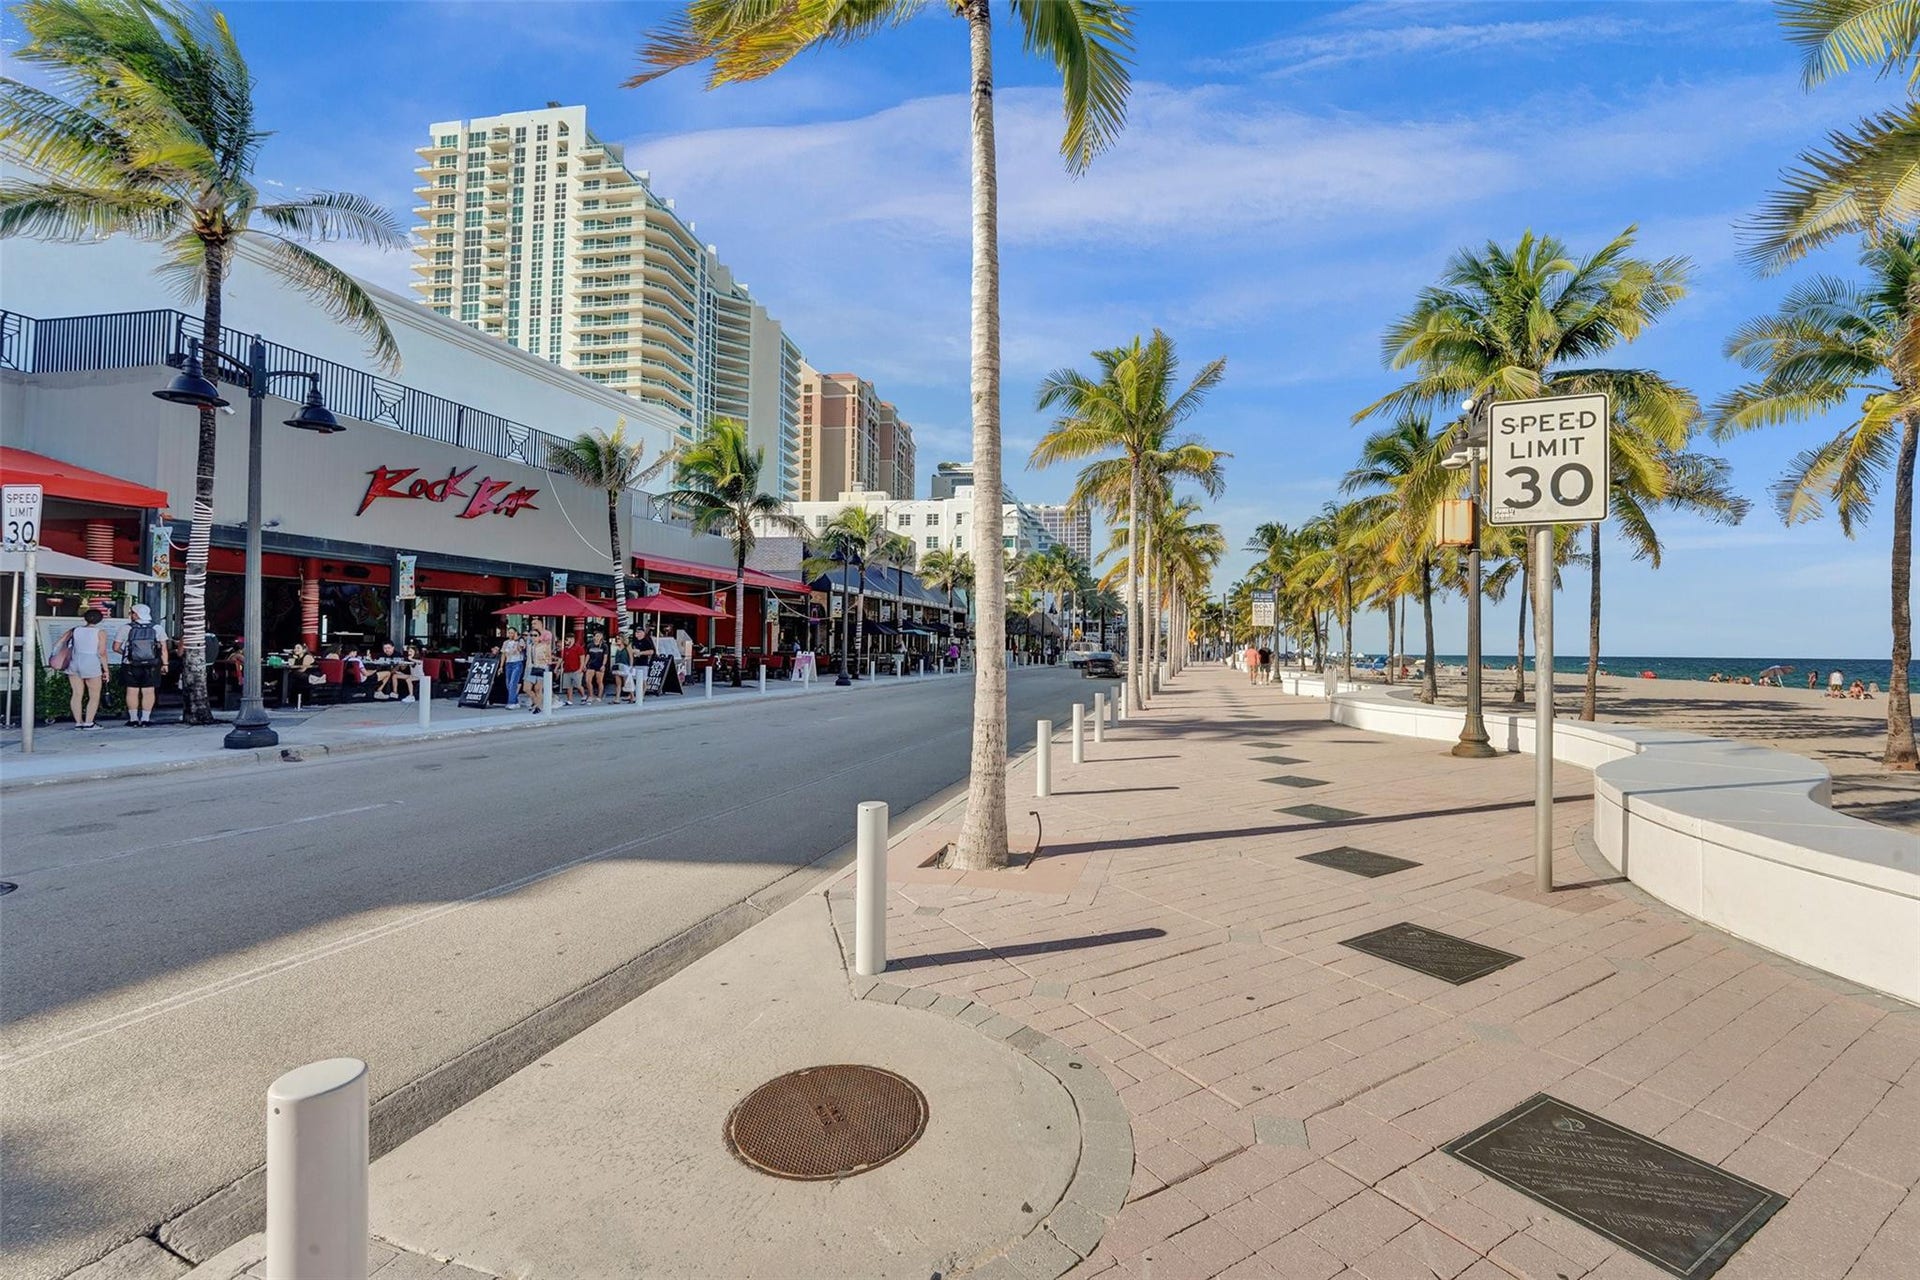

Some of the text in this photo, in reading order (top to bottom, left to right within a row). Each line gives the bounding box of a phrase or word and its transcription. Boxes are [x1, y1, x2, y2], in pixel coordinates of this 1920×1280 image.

[1500, 411, 1597, 435] SPEED
[1510, 437, 1585, 459] LIMIT
[1503, 463, 1594, 509] 30
[6, 493, 39, 504] SPEED
[9, 507, 34, 517] LIMIT
[8, 521, 35, 544] 30
[472, 661, 496, 674] 2-4-1
[464, 683, 489, 694] JUMBO
